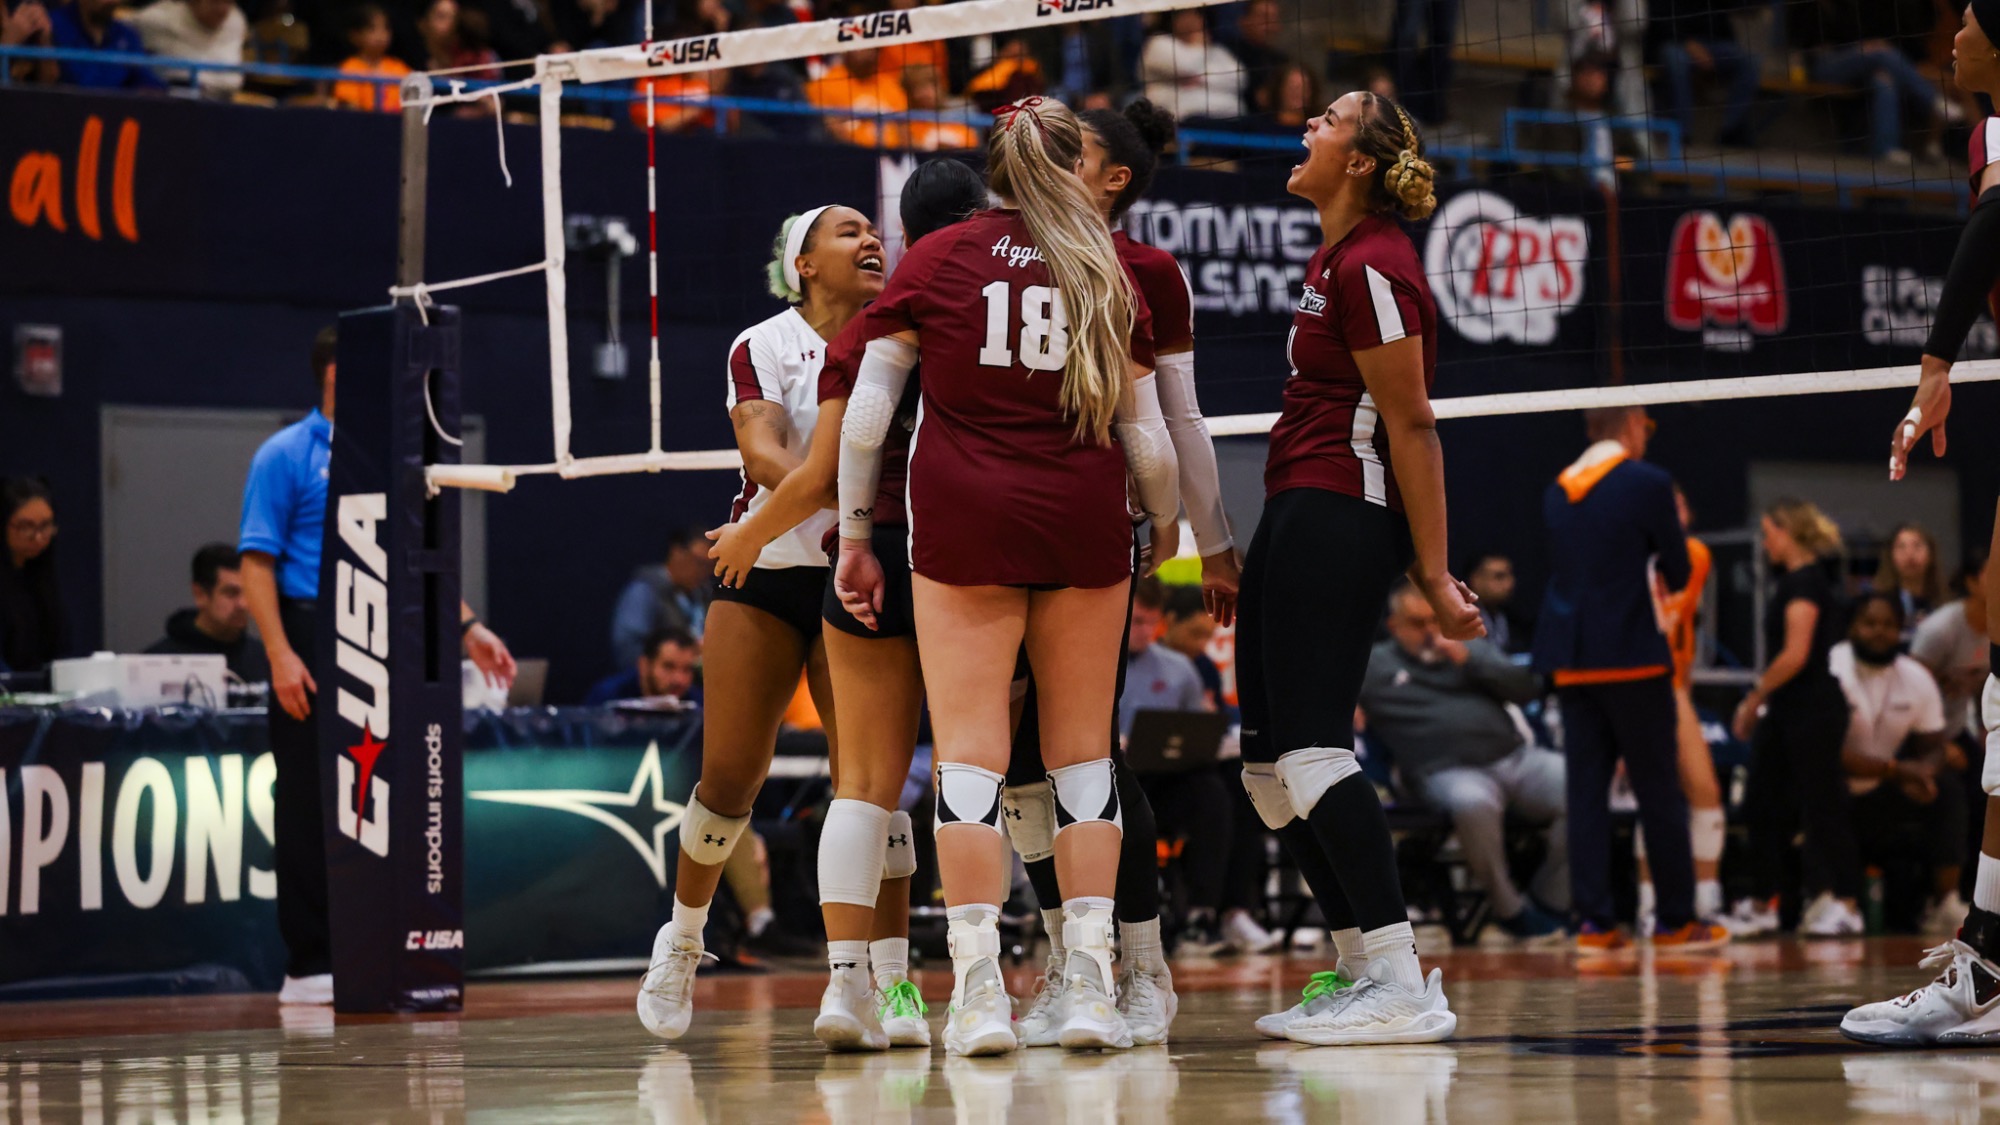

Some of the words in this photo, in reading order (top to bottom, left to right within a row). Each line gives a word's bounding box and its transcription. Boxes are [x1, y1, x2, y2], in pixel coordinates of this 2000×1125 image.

[9, 115, 140, 242] all
[978, 280, 1069, 372] 18
[425, 722, 445, 799] sports
[0, 751, 278, 917] PIONS
[424, 801, 445, 895] imports
